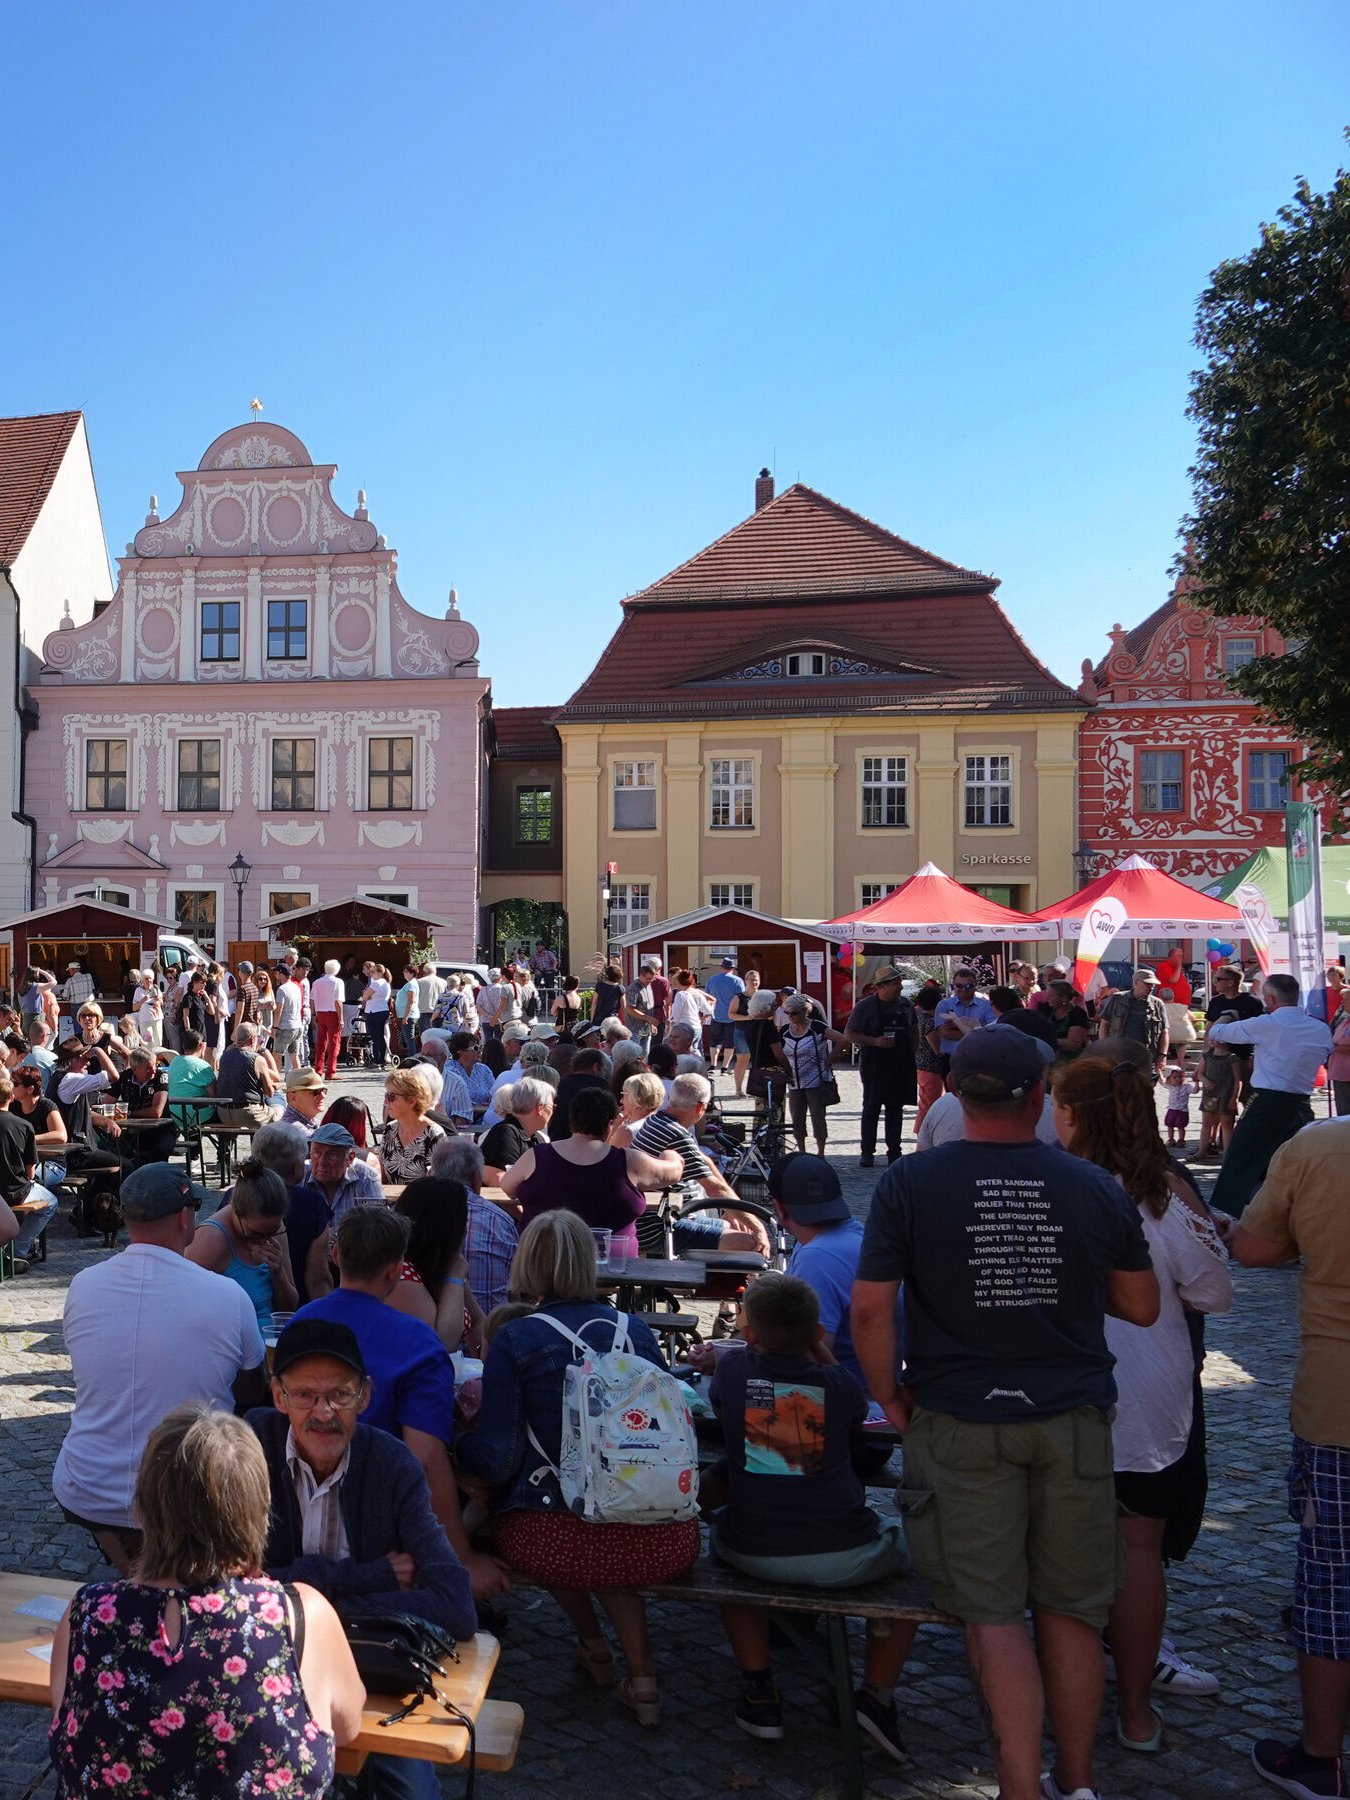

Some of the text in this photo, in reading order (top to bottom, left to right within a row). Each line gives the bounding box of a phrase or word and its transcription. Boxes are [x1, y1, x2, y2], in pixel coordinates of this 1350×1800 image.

[961, 853, 1032, 866] Sparkasse
[1096, 920, 1116, 935] AWO
[976, 1178, 1045, 1187] ENTER SANDMAN
[982, 1189, 1041, 1198] SAD BUT TRUE
[974, 1200, 1051, 1209] HOLIER THAN THOU
[979, 1212, 996, 1220] THE
[965, 1224, 1012, 1232] WHEREVER
[975, 1234, 1056, 1243] DON'T TRAD ON ME
[974, 1246, 1014, 1254] THROUGH
[968, 1256, 1064, 1265] NOTHING ELS MATTERS
[1016, 1266, 1028, 1274] AD
[1030, 1267, 1052, 1275] MAN
[1027, 1276, 1058, 1285] FAILED
[974, 1289, 989, 1297] MY
[1027, 1286, 1059, 1294] MISERY
[975, 1297, 1058, 1308] THE STRUGGE ITHIN
